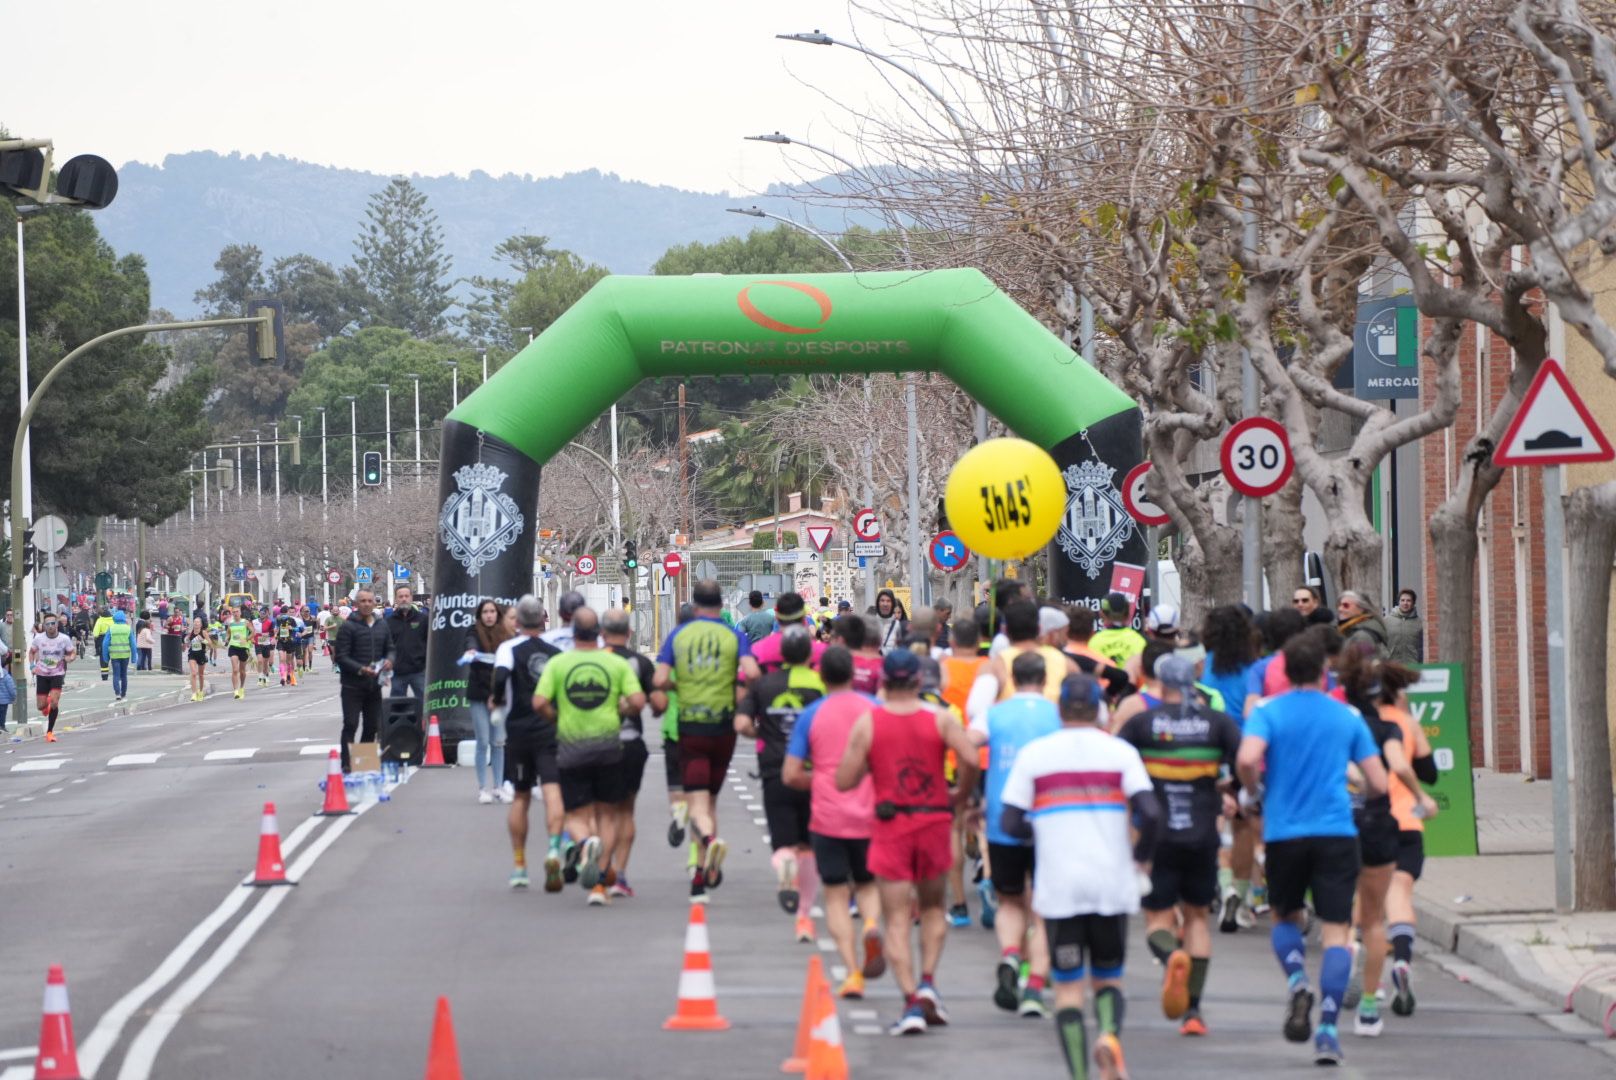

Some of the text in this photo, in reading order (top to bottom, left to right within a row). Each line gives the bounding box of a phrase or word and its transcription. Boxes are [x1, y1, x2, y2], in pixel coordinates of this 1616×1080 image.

[660, 340, 911, 355] PATRONAT D'ESPORTS
[1367, 377, 1420, 388] MERCAD
[1238, 444, 1279, 471] 30
[580, 561, 592, 570] 30
[432, 612, 446, 631] de
